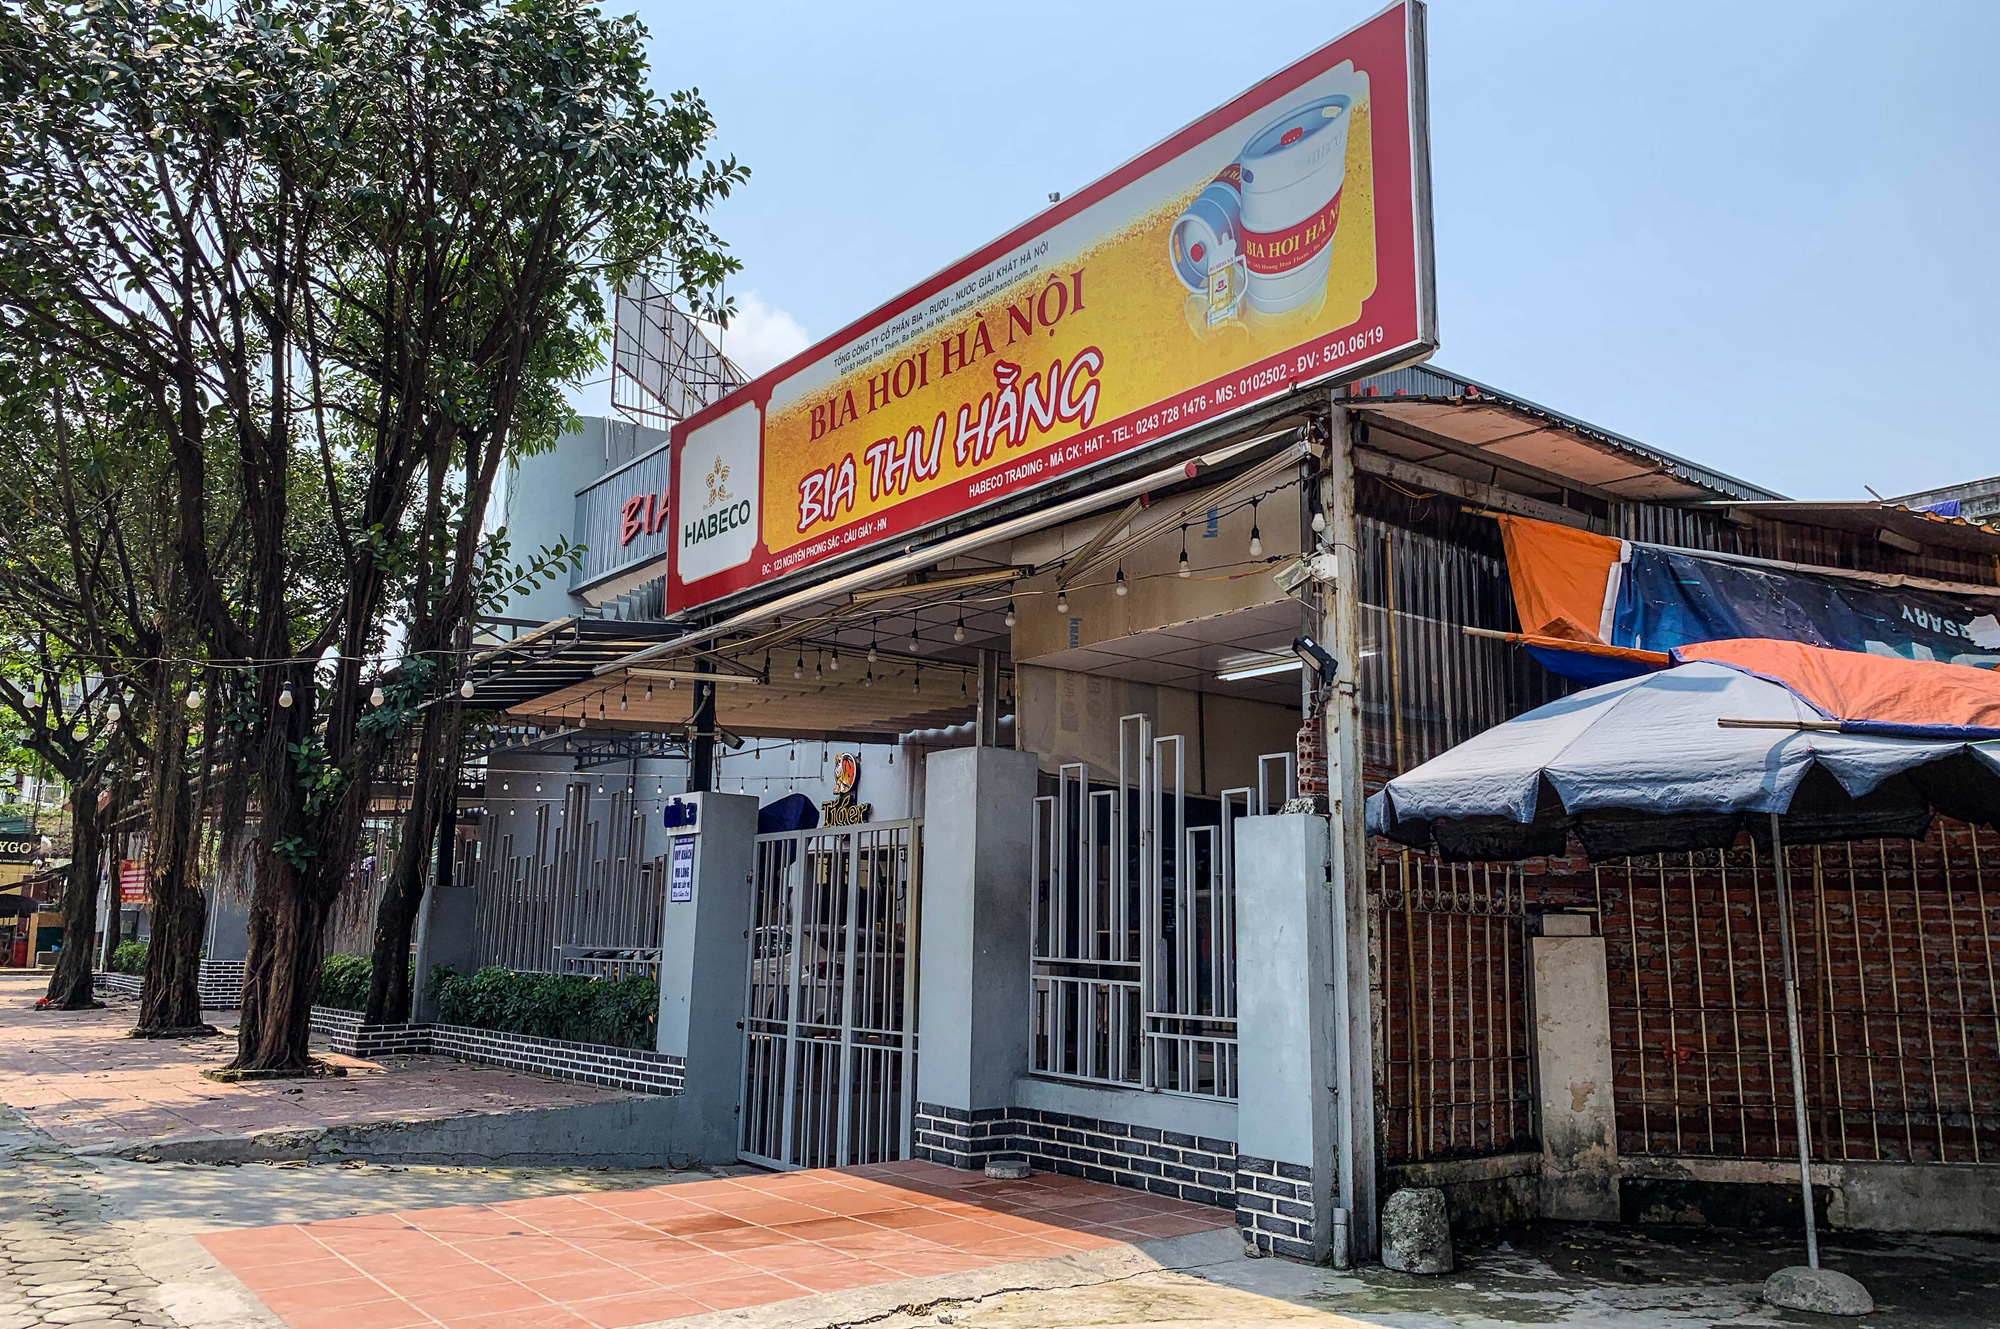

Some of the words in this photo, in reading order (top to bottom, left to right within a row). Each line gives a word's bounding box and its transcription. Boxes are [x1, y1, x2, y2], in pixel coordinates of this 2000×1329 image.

[1246, 239, 1265, 259] BIA
[1268, 234, 1300, 258] HƠI
[1304, 214, 1326, 246] HÀ
[834, 351, 850, 367] TỔNG
[852, 341, 870, 357] CÔNG
[871, 336, 879, 347] TY
[880, 325, 890, 341] CỔ
[892, 318, 910, 336] PHẦN
[912, 312, 923, 325] BIA
[929, 297, 949, 315] RƯỢU
[956, 282, 976, 301] NƯỚC
[978, 270, 994, 288] GIẢI
[997, 259, 1018, 279] KHÁT
[1020, 249, 1032, 266] HÀ
[1034, 241, 1049, 256] NỘI
[809, 388, 859, 443] BIA
[867, 349, 930, 415] HƠI
[940, 312, 996, 378] HÀ
[1005, 267, 1086, 347] NỘI
[901, 334, 910, 343] Ba
[926, 320, 934, 330] Hà
[969, 473, 1003, 498] HABECO
[1004, 461, 1043, 485] TRADING
[1050, 452, 1064, 468] MÃ
[1066, 445, 1083, 462] CK:
[1084, 434, 1105, 455] HAT
[1112, 426, 1134, 446] TEL:
[1136, 415, 1160, 436] 0243
[1161, 409, 1180, 427] 728
[1182, 398, 1207, 418] 1476
[1215, 384, 1237, 405] MS:
[1239, 363, 1287, 395] 0102502
[1297, 352, 1320, 374] ĐV:
[1323, 325, 1384, 363] 520.06/19
[797, 454, 856, 531] BIA
[865, 411, 946, 501] THU
[955, 347, 1103, 466] HẰNG
[684, 500, 750, 548] HABECO
[773, 560, 783, 571] 123
[806, 542, 827, 560] PHONG
[877, 517, 887, 531] HN
[821, 795, 871, 828] Tiger
